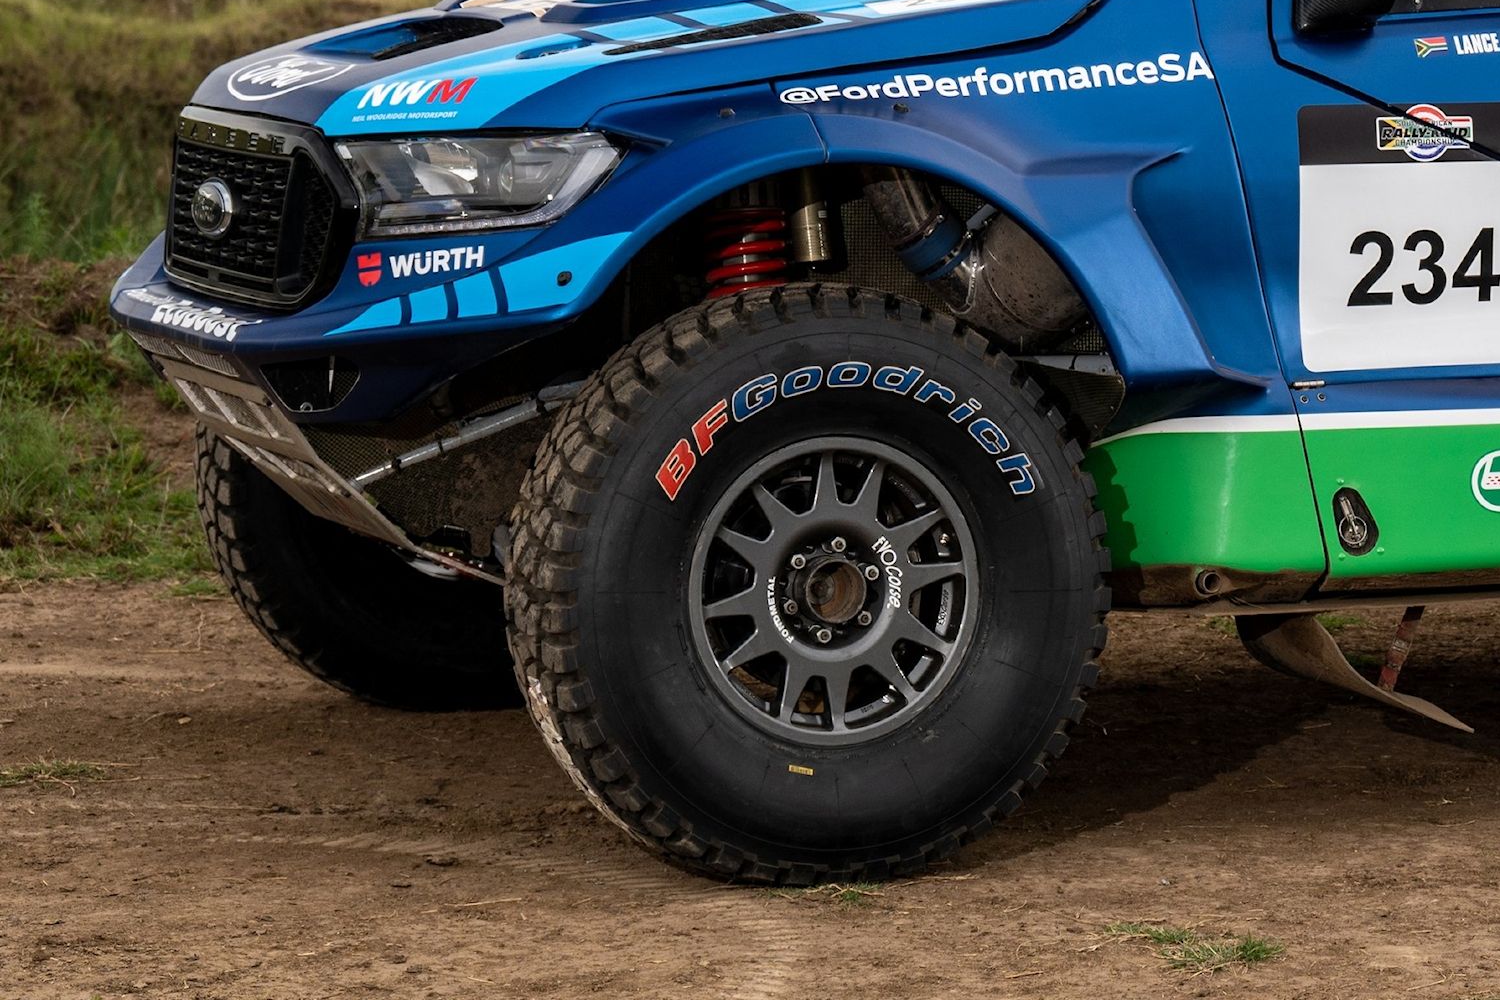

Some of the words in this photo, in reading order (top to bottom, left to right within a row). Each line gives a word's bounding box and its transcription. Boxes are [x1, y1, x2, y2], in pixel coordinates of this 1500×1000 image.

[1453, 32, 1500, 55] LANCE
[356, 76, 479, 110] NWM
[779, 51, 1215, 104] @FordPerformanceSA
[351, 115, 365, 123] NEIL
[366, 112, 407, 122] WOOLRIDGE
[407, 110, 458, 120] MOTORSPORT
[389, 244, 485, 279] WÜRTH
[1346, 226, 1500, 307] 234
[654, 360, 1039, 501] BFGoodrich
[766, 576, 795, 644] FONDMETAL
